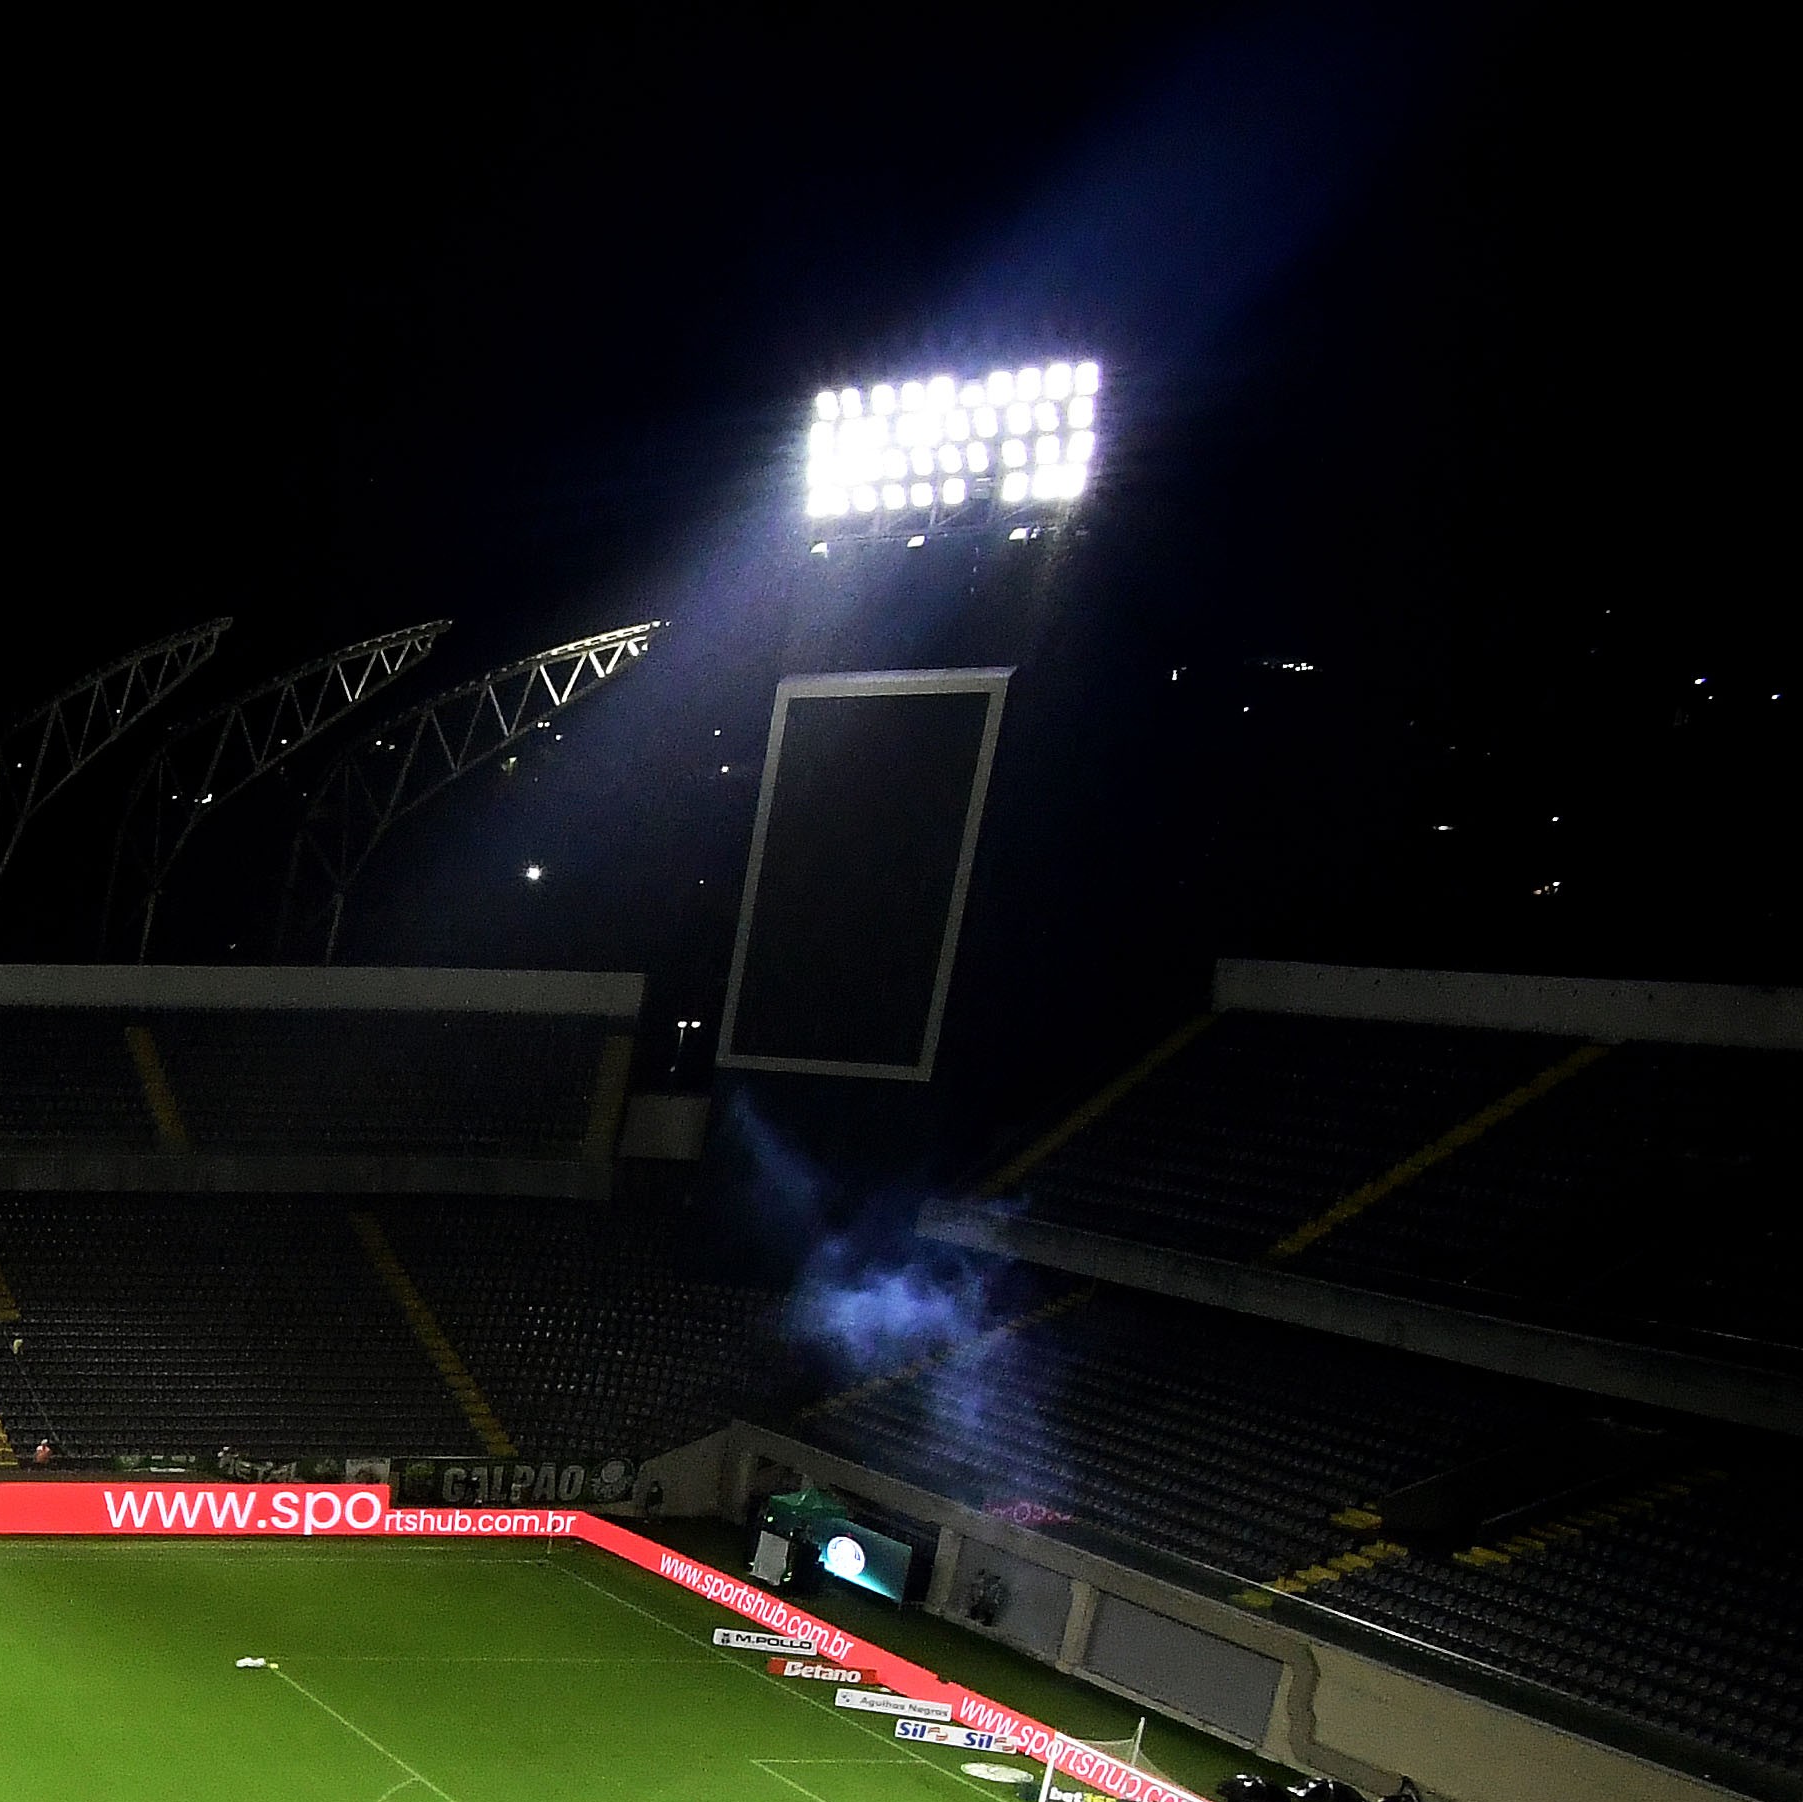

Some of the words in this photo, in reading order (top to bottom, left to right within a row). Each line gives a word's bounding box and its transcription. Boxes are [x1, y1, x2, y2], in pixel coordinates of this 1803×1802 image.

[659, 1552, 854, 1661] www.sportshub.com.br
[735, 1633, 813, 1651] M.POLLO
[783, 1661, 862, 1684] Betano
